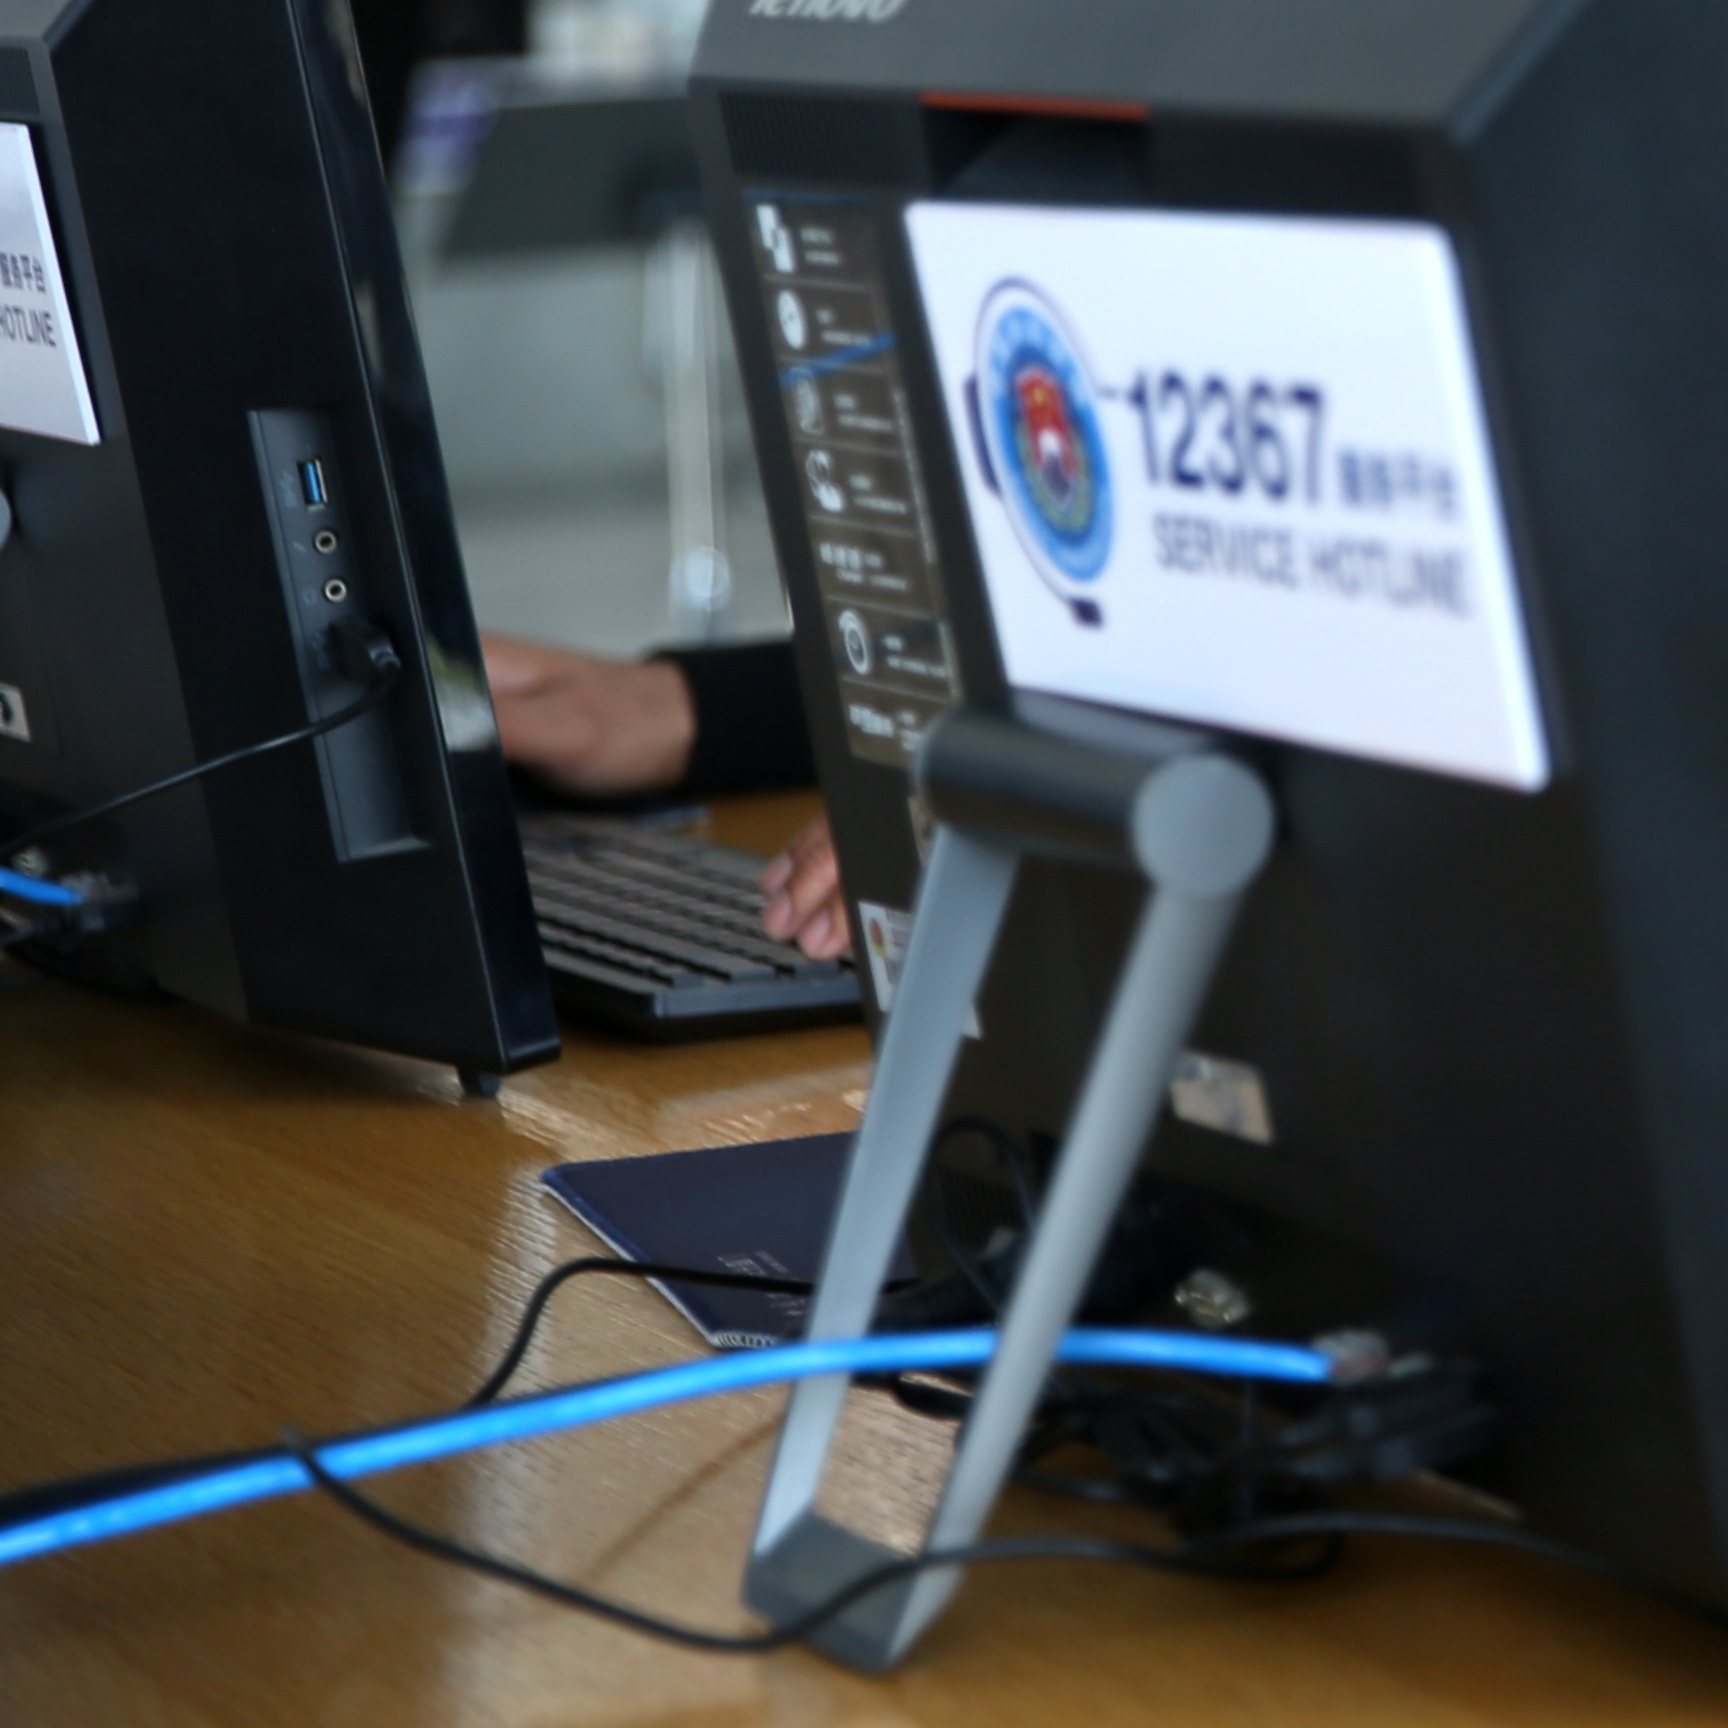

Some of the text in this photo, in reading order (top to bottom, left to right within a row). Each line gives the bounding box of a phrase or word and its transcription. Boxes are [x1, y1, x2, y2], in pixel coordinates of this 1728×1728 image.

[1126, 366, 1324, 506] 12367
[1152, 510, 1470, 620] SERVICE HOTLINE
